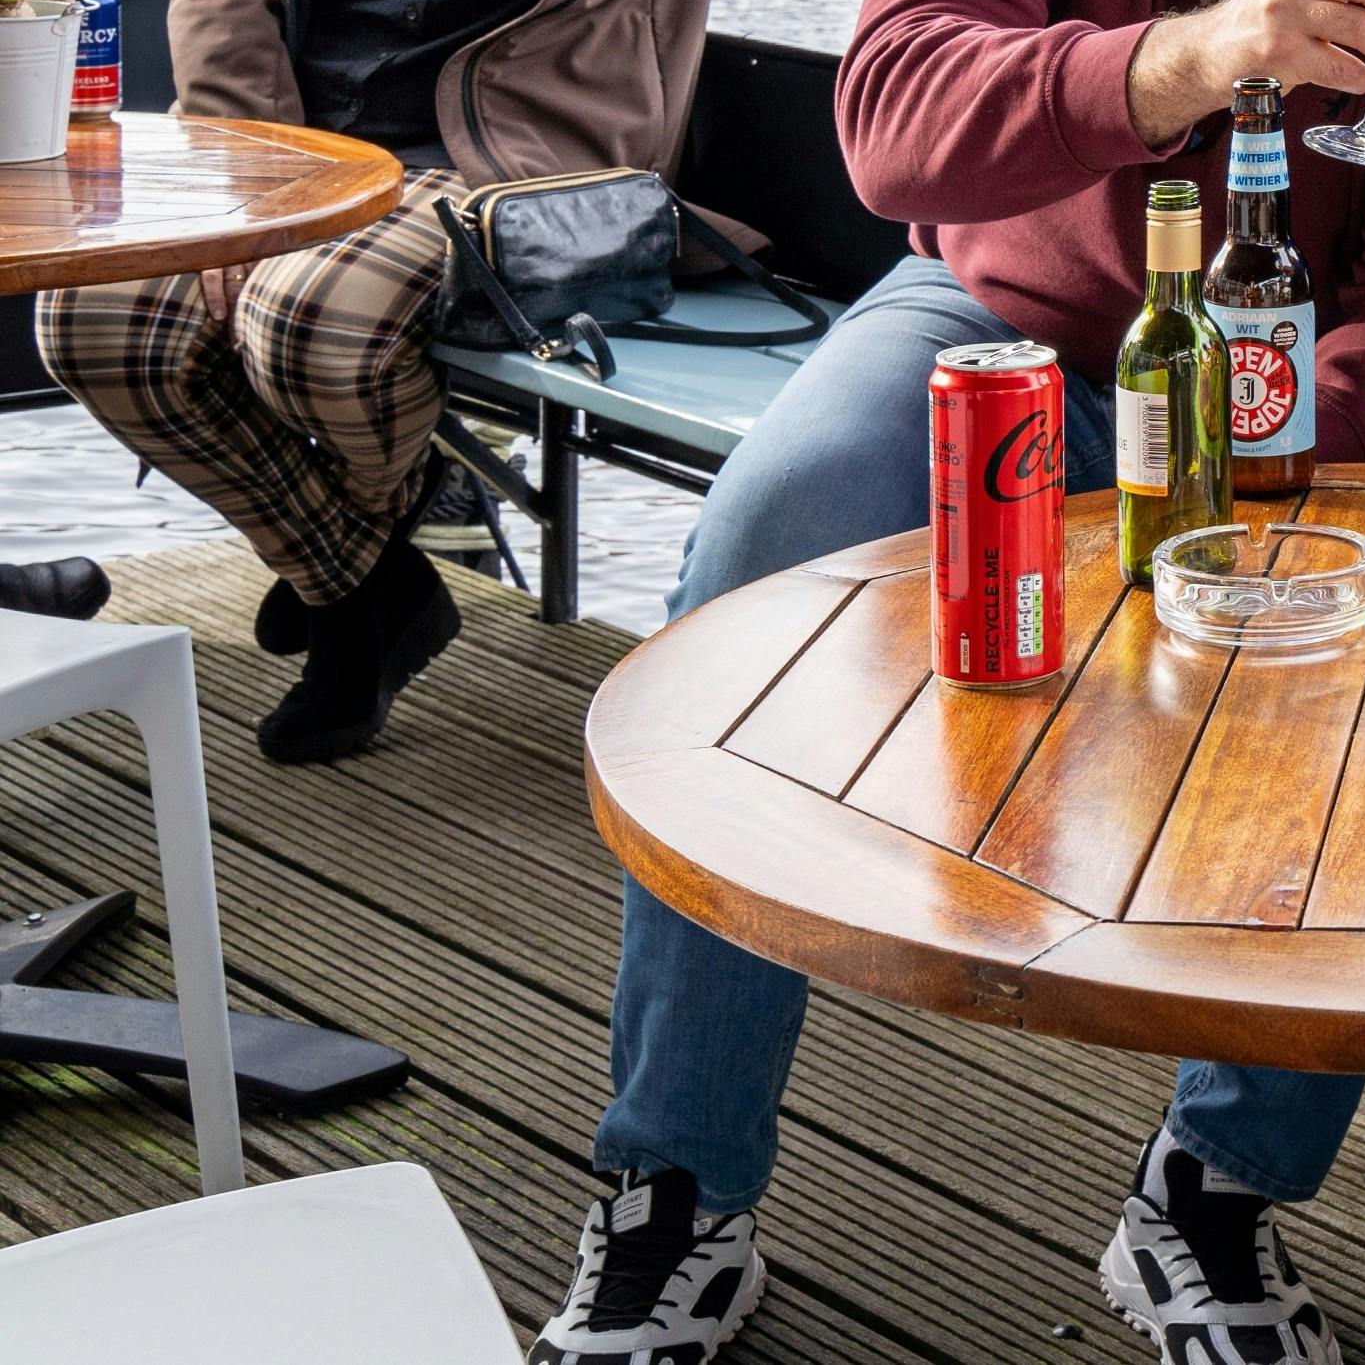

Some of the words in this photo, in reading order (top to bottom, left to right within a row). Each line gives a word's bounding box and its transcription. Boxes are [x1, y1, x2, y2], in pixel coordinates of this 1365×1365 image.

[80, 27, 116, 44] RCY
[1237, 151, 1281, 163] WITBIER
[1235, 174, 1281, 186] WITBIER
[1221, 311, 1277, 323] ADRIAAN
[1236, 324, 1260, 334] WIT
[1231, 346, 1283, 378] PEN
[1232, 389, 1292, 435] JOPE
[984, 547, 1000, 579] ME
[984, 585, 1000, 673] RECYCLE
